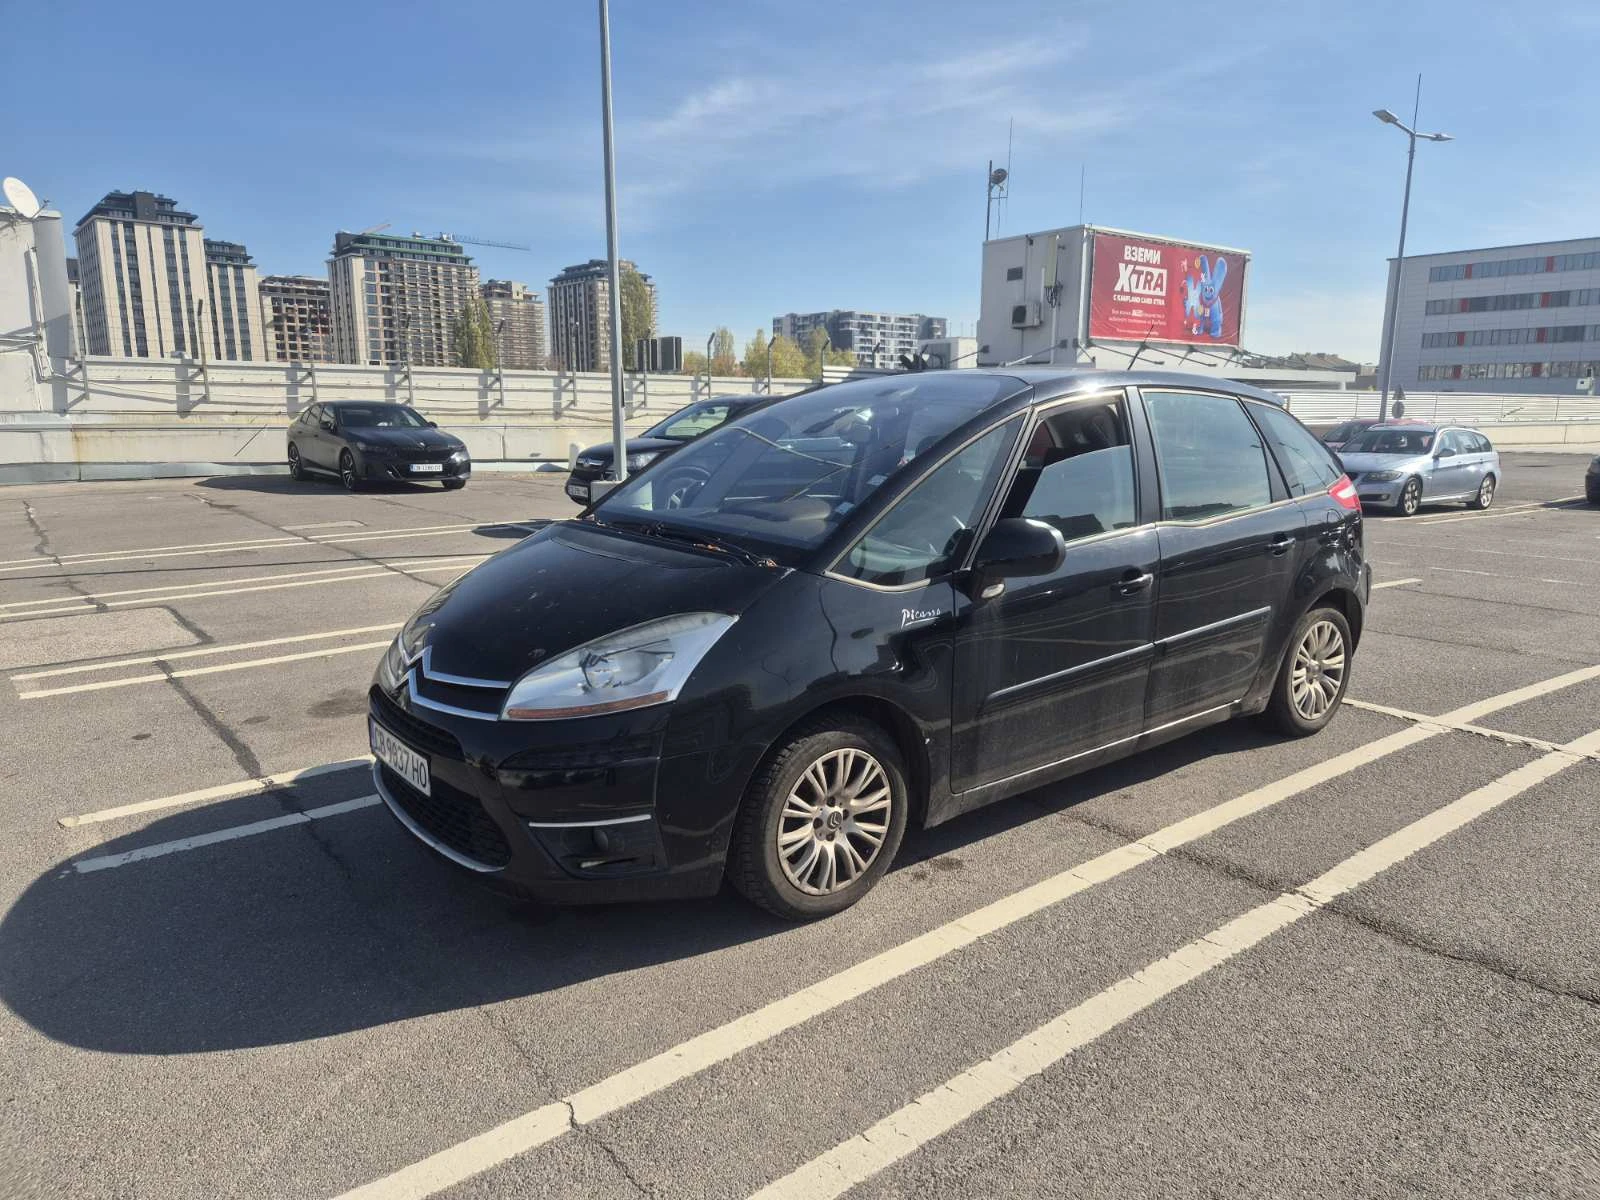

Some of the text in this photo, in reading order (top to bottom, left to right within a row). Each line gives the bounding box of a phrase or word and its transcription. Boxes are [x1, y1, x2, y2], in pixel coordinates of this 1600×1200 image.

[1124, 244, 1161, 264] ВЗЕМИ
[1114, 262, 1167, 296] XTRA
[412, 754, 427, 788] HO
